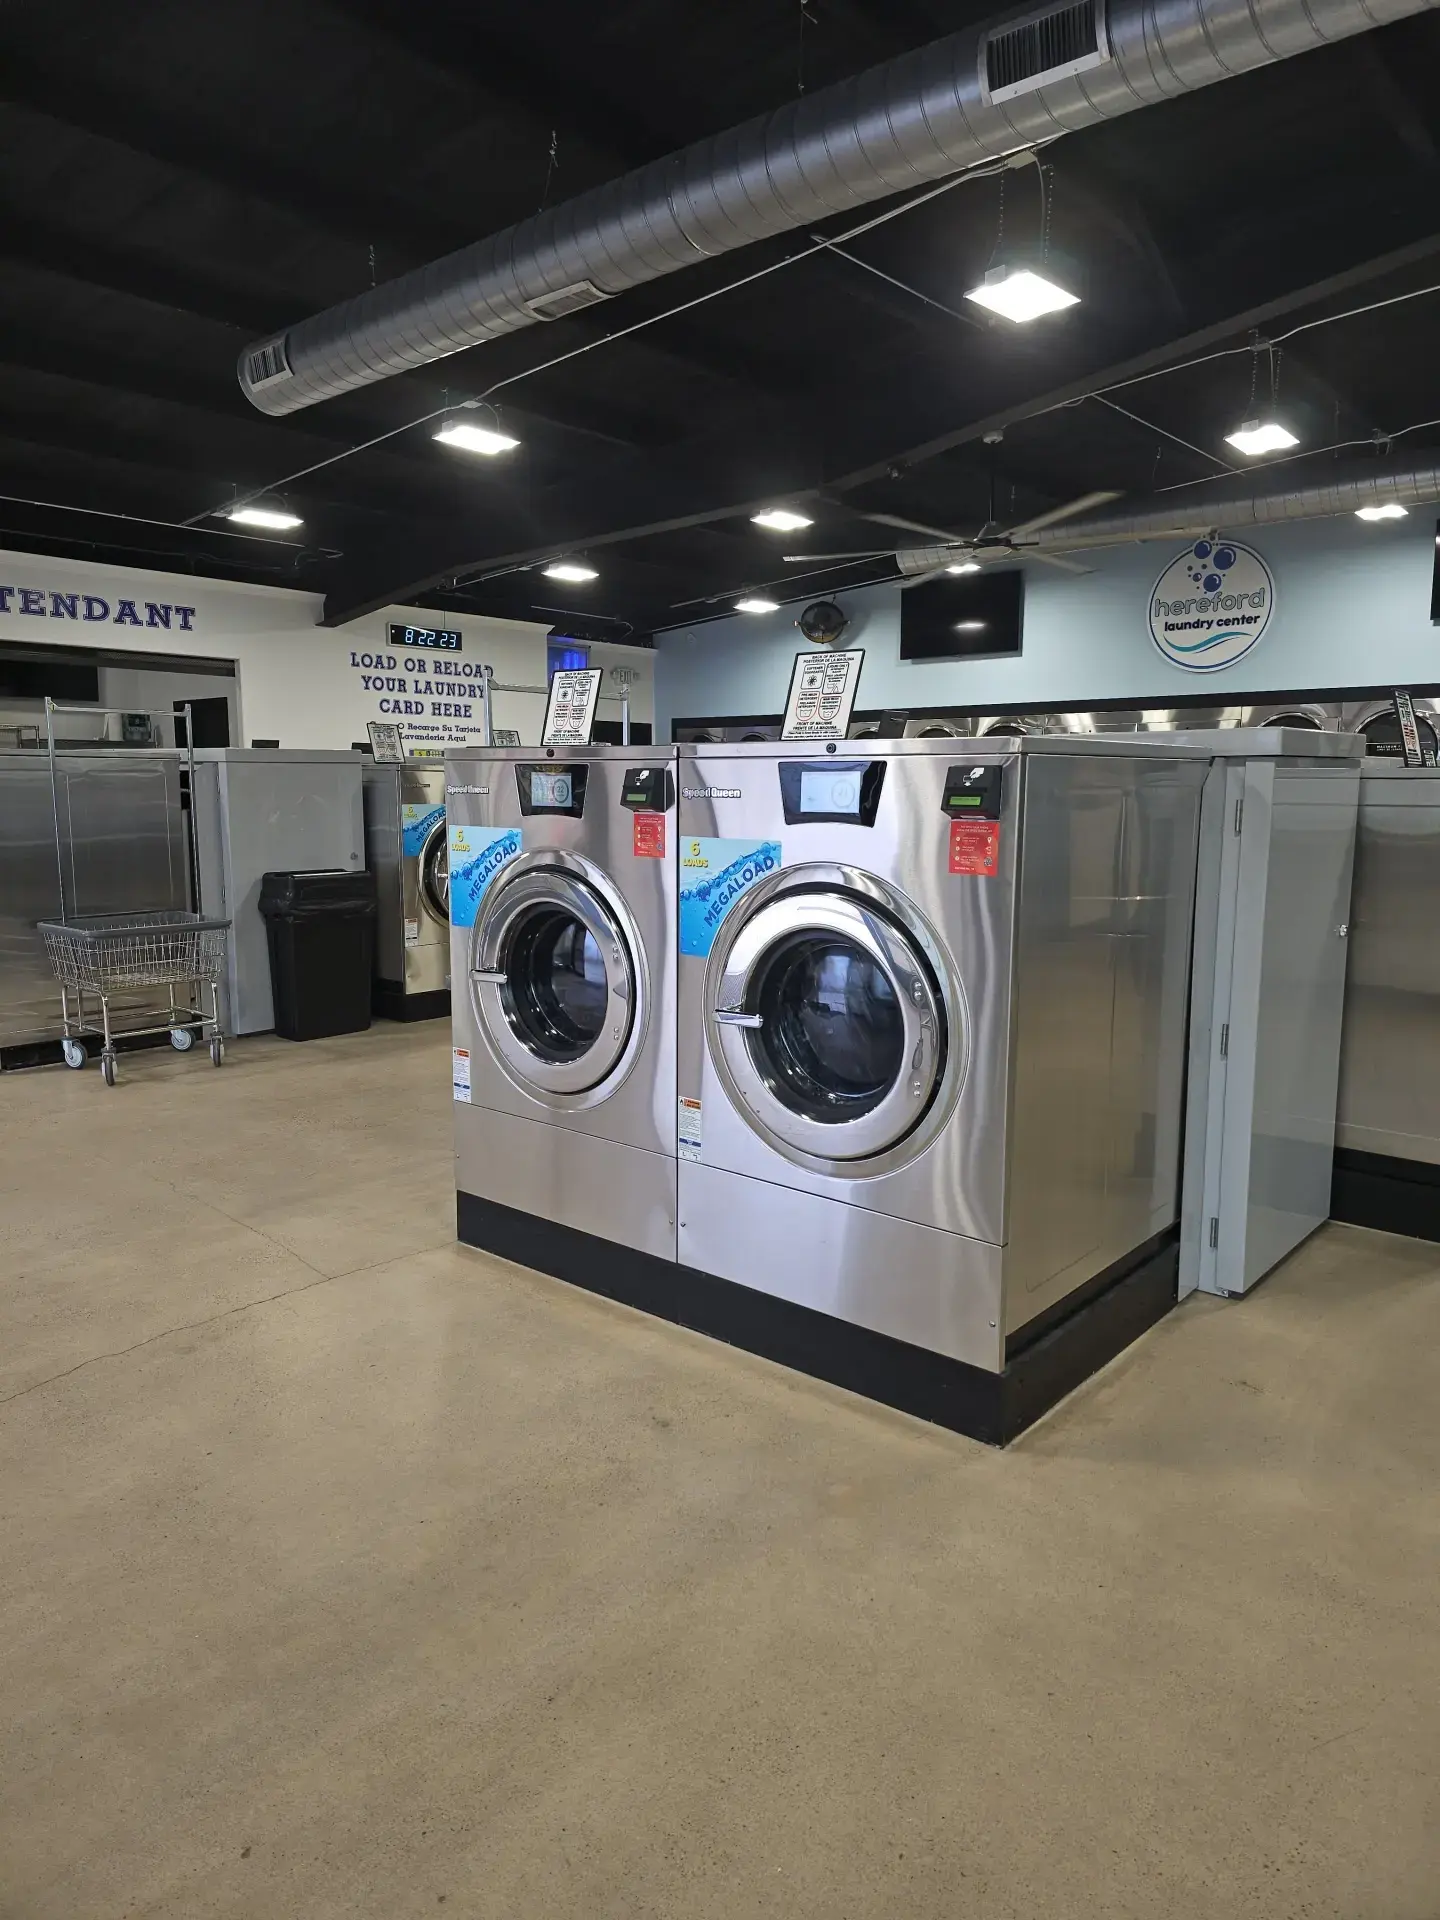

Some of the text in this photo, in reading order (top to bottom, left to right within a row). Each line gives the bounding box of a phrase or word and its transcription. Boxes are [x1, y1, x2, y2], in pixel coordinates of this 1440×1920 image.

[1155, 587, 1265, 617] hereford
[1164, 614, 1260, 631] laundry center
[405, 629, 457, 648] 8 22 23
[350, 652, 494, 678] LOAD OR RELOAD
[361, 675, 484, 699] YOUR LAUNDRY
[379, 699, 472, 718] CARD HERE
[407, 723, 440, 732] Recarge
[455, 725, 481, 733] Tarjeta
[711, 787, 741, 798] Queen
[457, 829, 464, 842] 6
[691, 842, 701, 856] 6
[468, 840, 518, 902] MEGALOAD
[683, 858, 709, 868] LOADS
[703, 855, 775, 927] MEGALOAD
